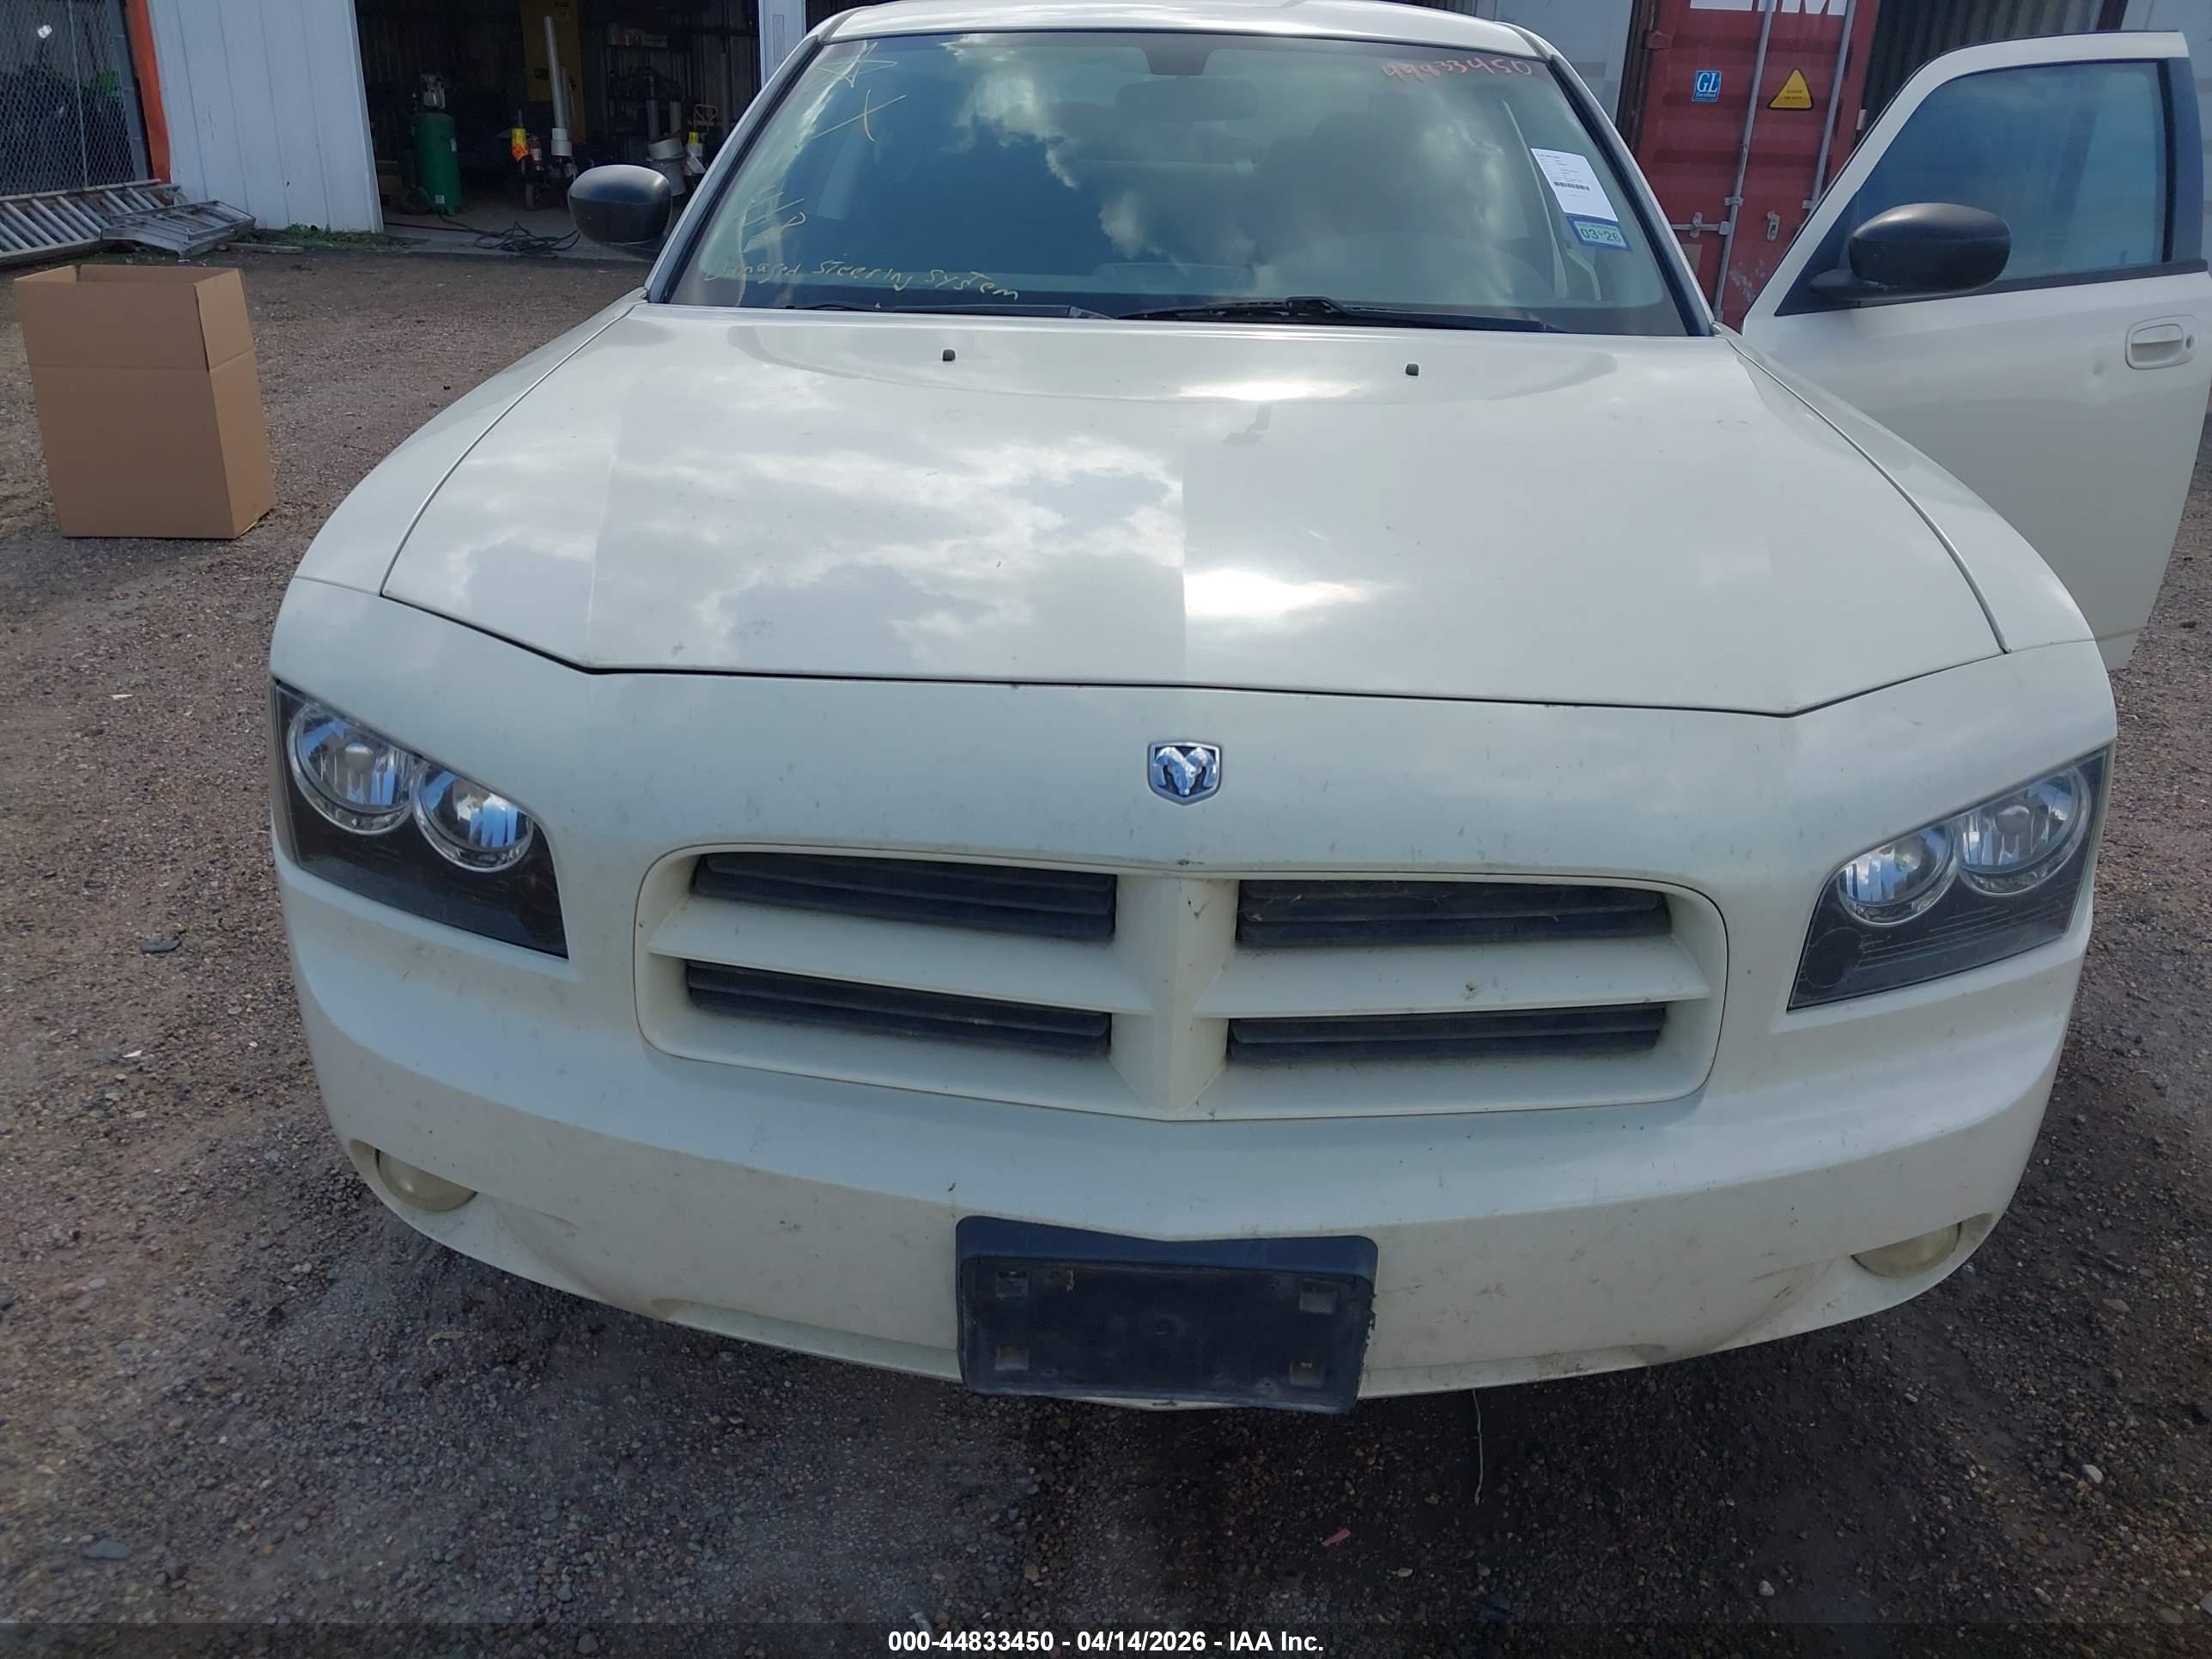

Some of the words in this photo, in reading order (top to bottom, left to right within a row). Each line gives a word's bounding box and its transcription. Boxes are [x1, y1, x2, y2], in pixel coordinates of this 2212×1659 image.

[1697, 72, 1718, 93] GL
[1580, 228, 1599, 240] 03
[1604, 230, 1622, 243] 26
